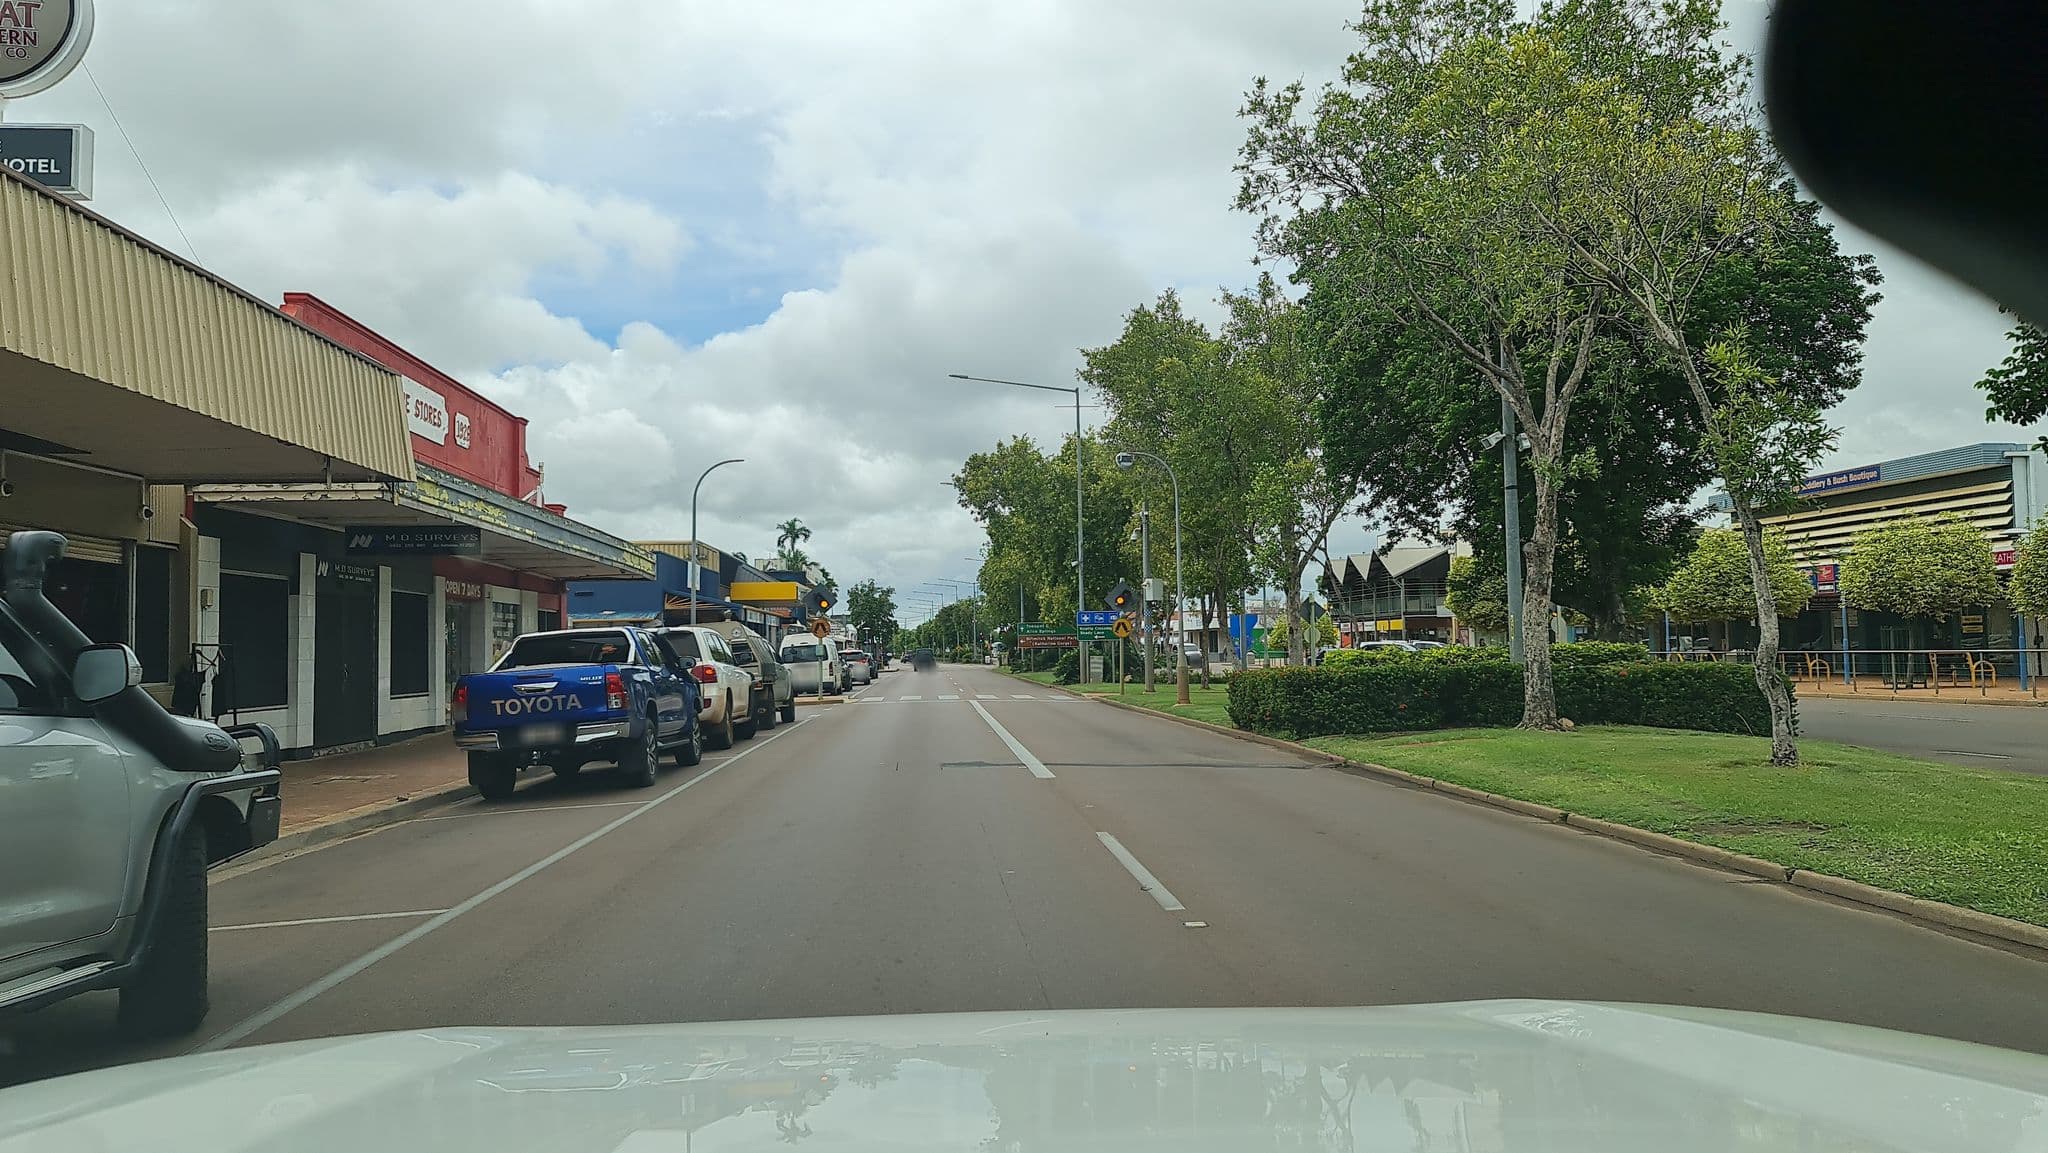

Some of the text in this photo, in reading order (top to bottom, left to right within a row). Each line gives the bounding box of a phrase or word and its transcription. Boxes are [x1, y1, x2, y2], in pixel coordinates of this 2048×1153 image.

[3, 158, 61, 174] OTEL
[415, 399, 441, 428] STORES
[1827, 478, 1833, 486] &
[1833, 474, 1849, 486] Bush
[1849, 470, 1878, 483] Boutique
[385, 534, 396, 542] M
[415, 533, 479, 542] SURVEYS
[446, 580, 461, 595] OPEN
[467, 583, 482, 598] DAYS
[491, 693, 583, 716] TOYOTA
